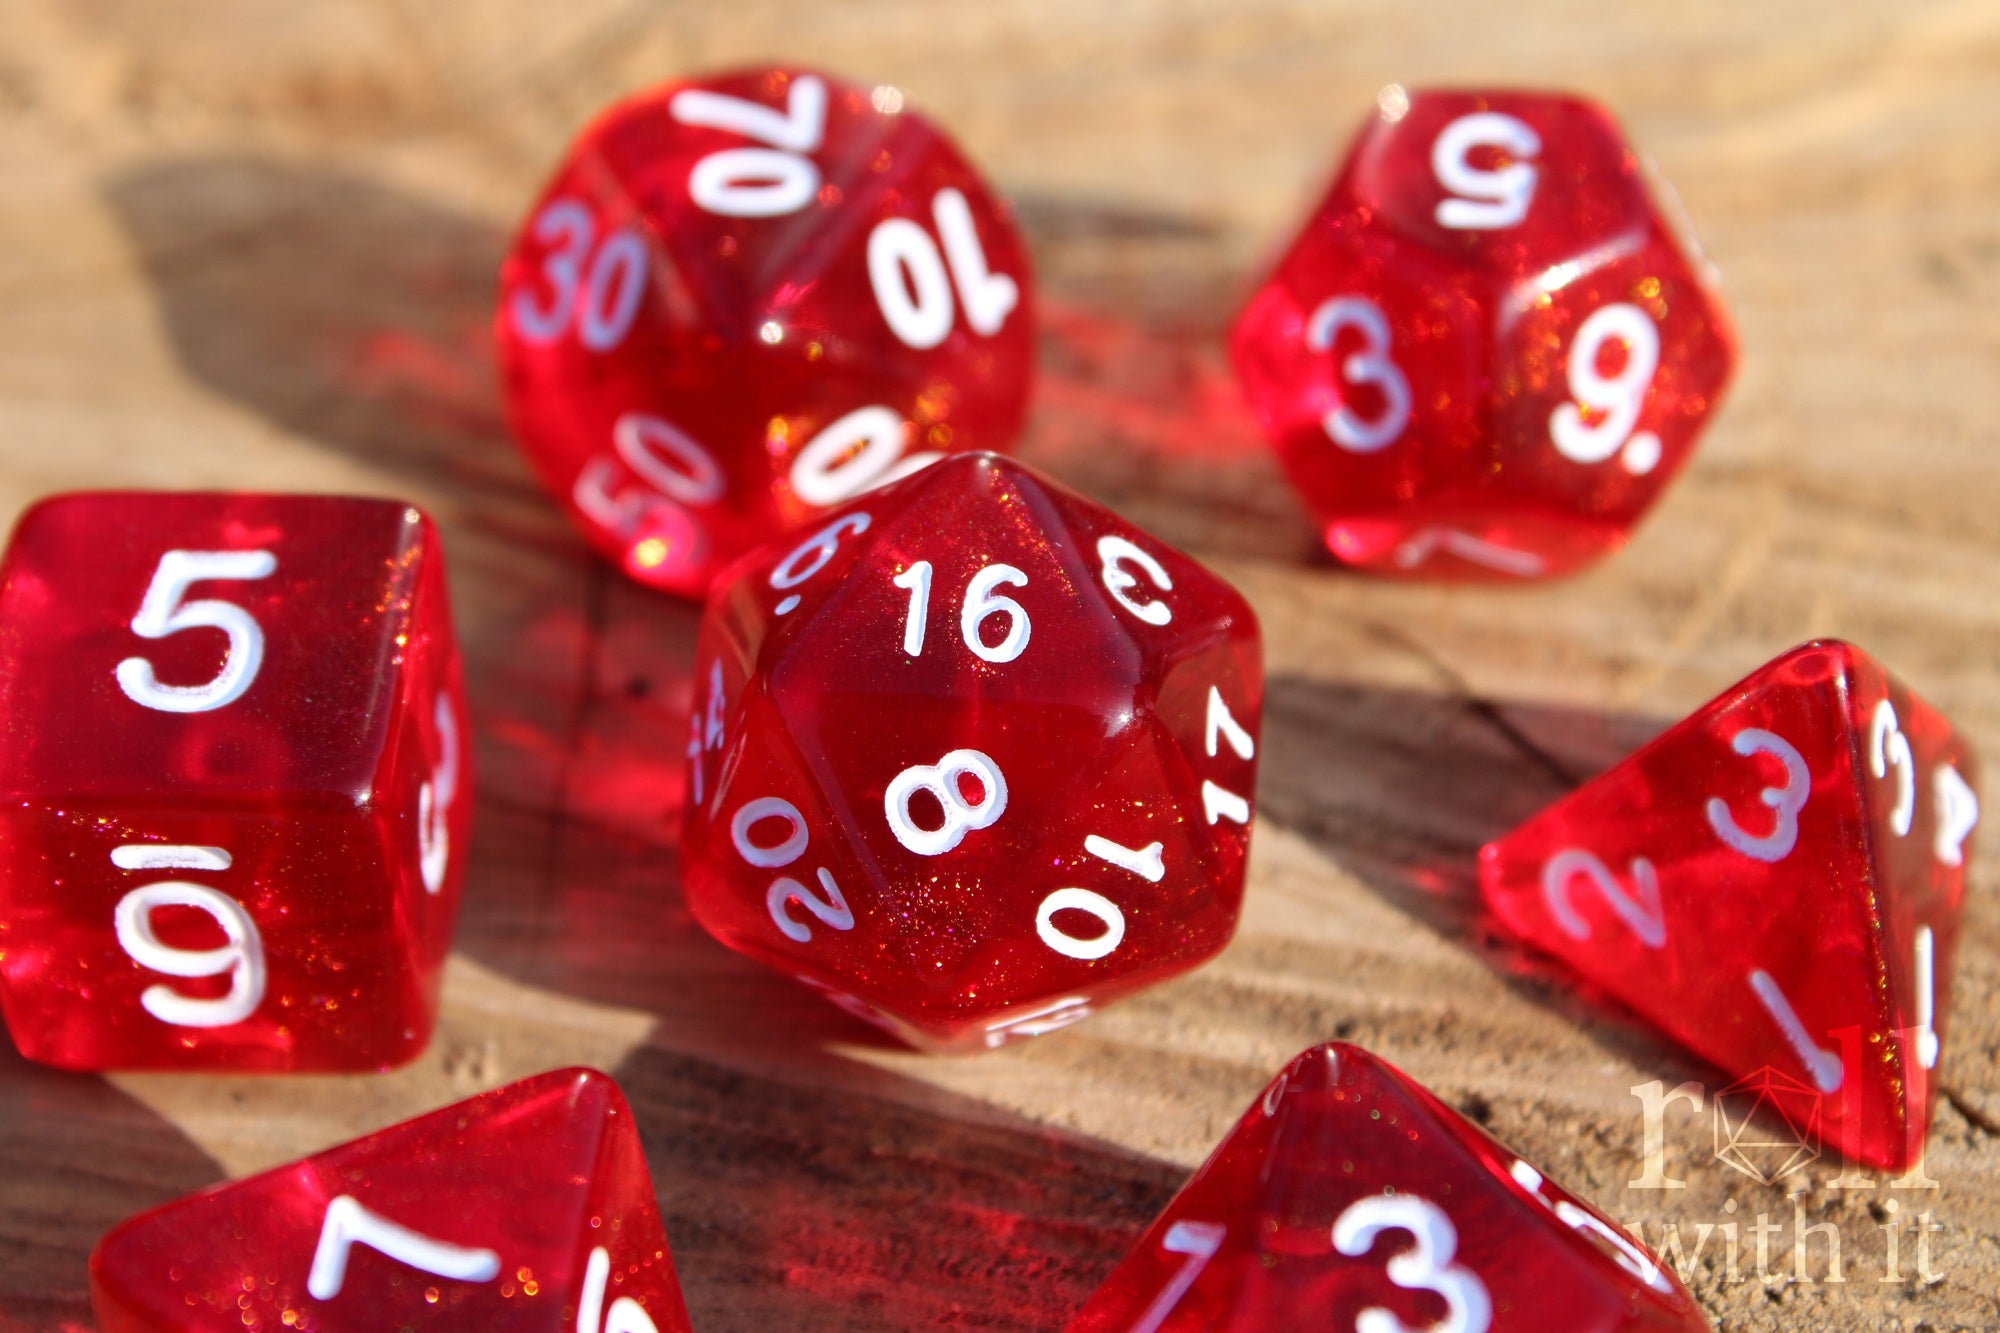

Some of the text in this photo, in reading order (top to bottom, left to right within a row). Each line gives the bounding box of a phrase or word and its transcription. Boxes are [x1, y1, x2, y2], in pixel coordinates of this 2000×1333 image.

[670, 75, 826, 217] 70
[1432, 112, 1541, 229] 5
[512, 199, 648, 352] 30
[867, 187, 1018, 349] 10
[1306, 294, 1411, 453] 3
[116, 549, 277, 713] 5
[893, 560, 1031, 664] 16
[1096, 535, 1173, 626] 3
[884, 748, 1008, 856] 8
[1202, 685, 1254, 826] 17
[1706, 727, 1811, 862] 3
[1871, 699, 1915, 837] 3
[731, 796, 855, 943] 20
[1035, 833, 1166, 960] 10
[1542, 849, 1665, 948] 2
[1749, 969, 1843, 1093] 1
[308, 1194, 500, 1301] 7
[1331, 1193, 1493, 1333] 3
